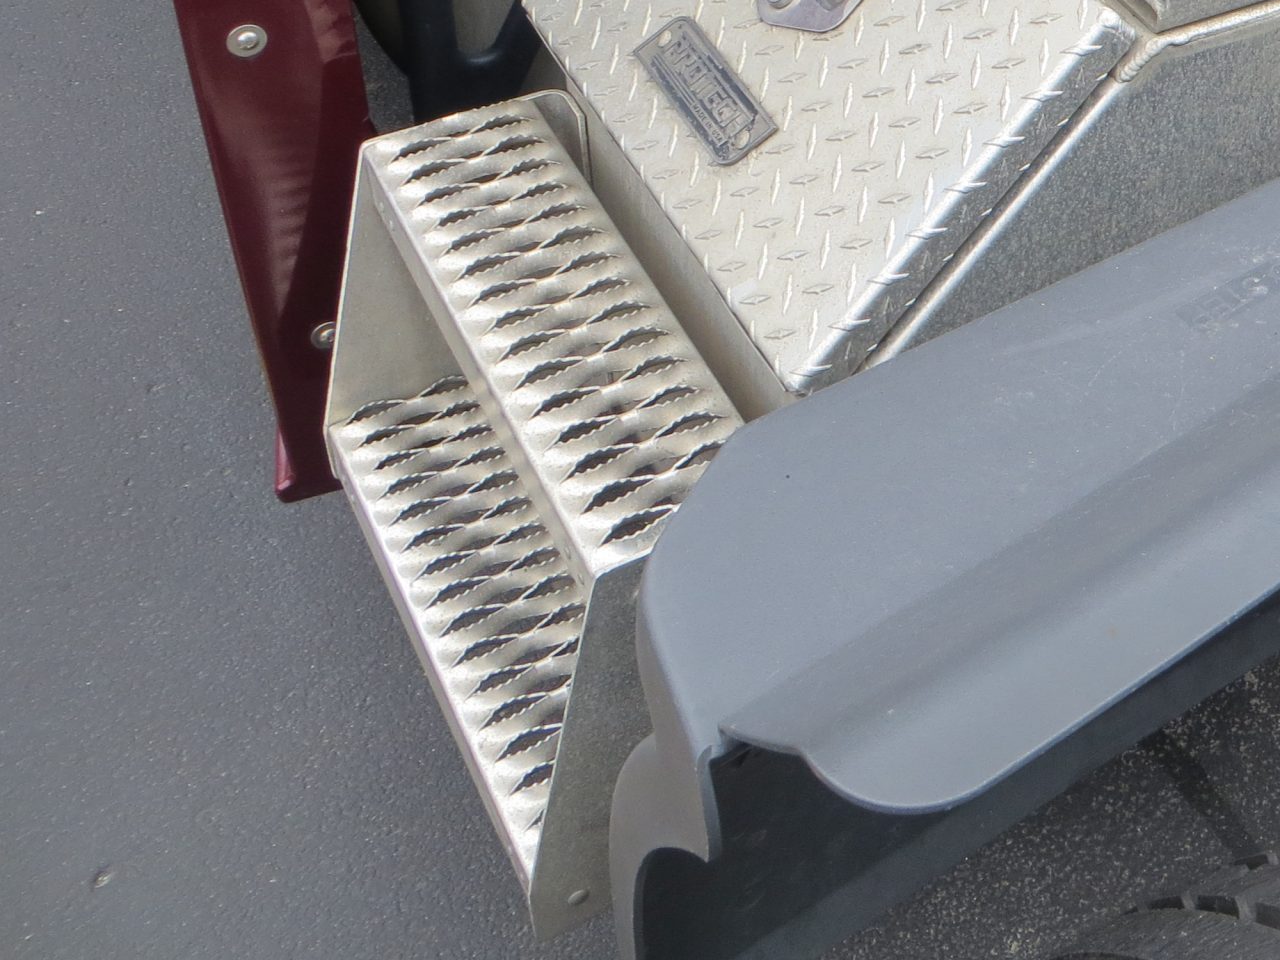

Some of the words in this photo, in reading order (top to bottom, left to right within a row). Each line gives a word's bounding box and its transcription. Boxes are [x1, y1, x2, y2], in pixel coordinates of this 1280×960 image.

[690, 103, 708, 122] MADE
[703, 119, 714, 130] IN
[709, 127, 724, 143] USA
